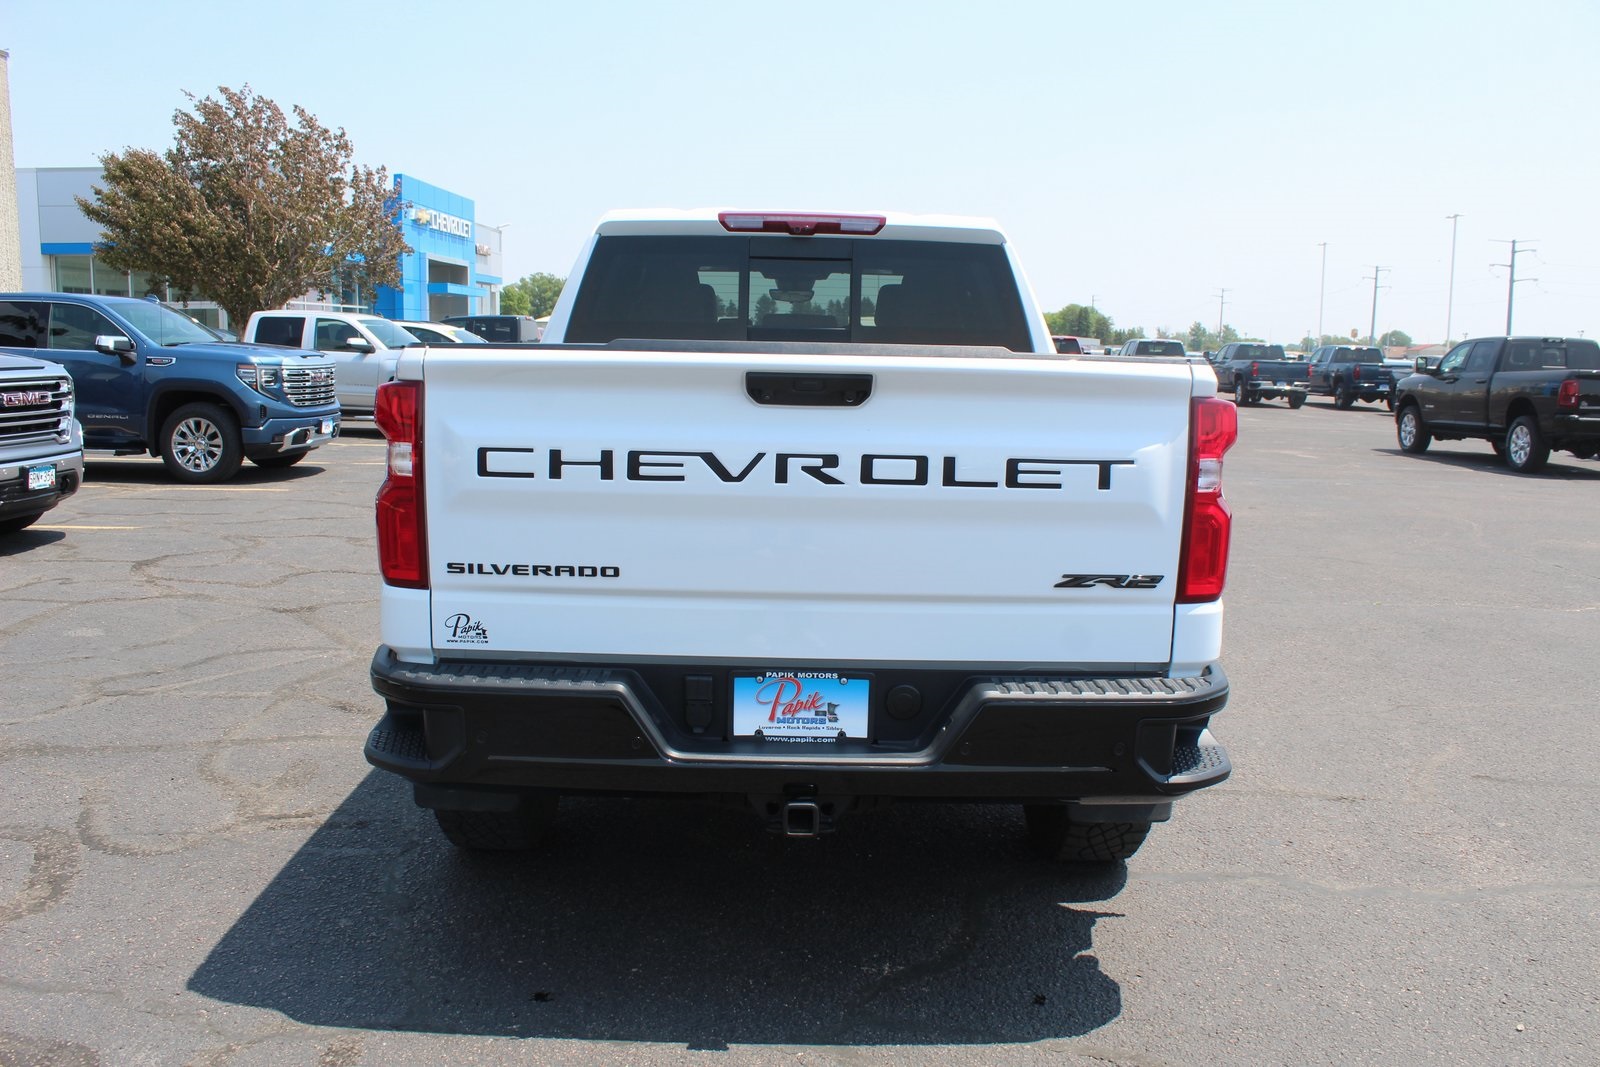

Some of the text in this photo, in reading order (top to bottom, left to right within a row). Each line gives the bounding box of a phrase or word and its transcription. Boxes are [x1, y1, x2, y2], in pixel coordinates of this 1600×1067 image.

[430, 211, 472, 238] CHEVROLET
[3, 391, 51, 407] GMC
[477, 446, 1135, 490] CHEVROLET
[446, 562, 620, 578] SILVERADO
[1053, 573, 1165, 588] ZR2
[444, 613, 484, 638] Papik
[765, 671, 795, 679] PAPIK
[755, 677, 826, 722] Papik
[776, 717, 827, 725] MOTORS
